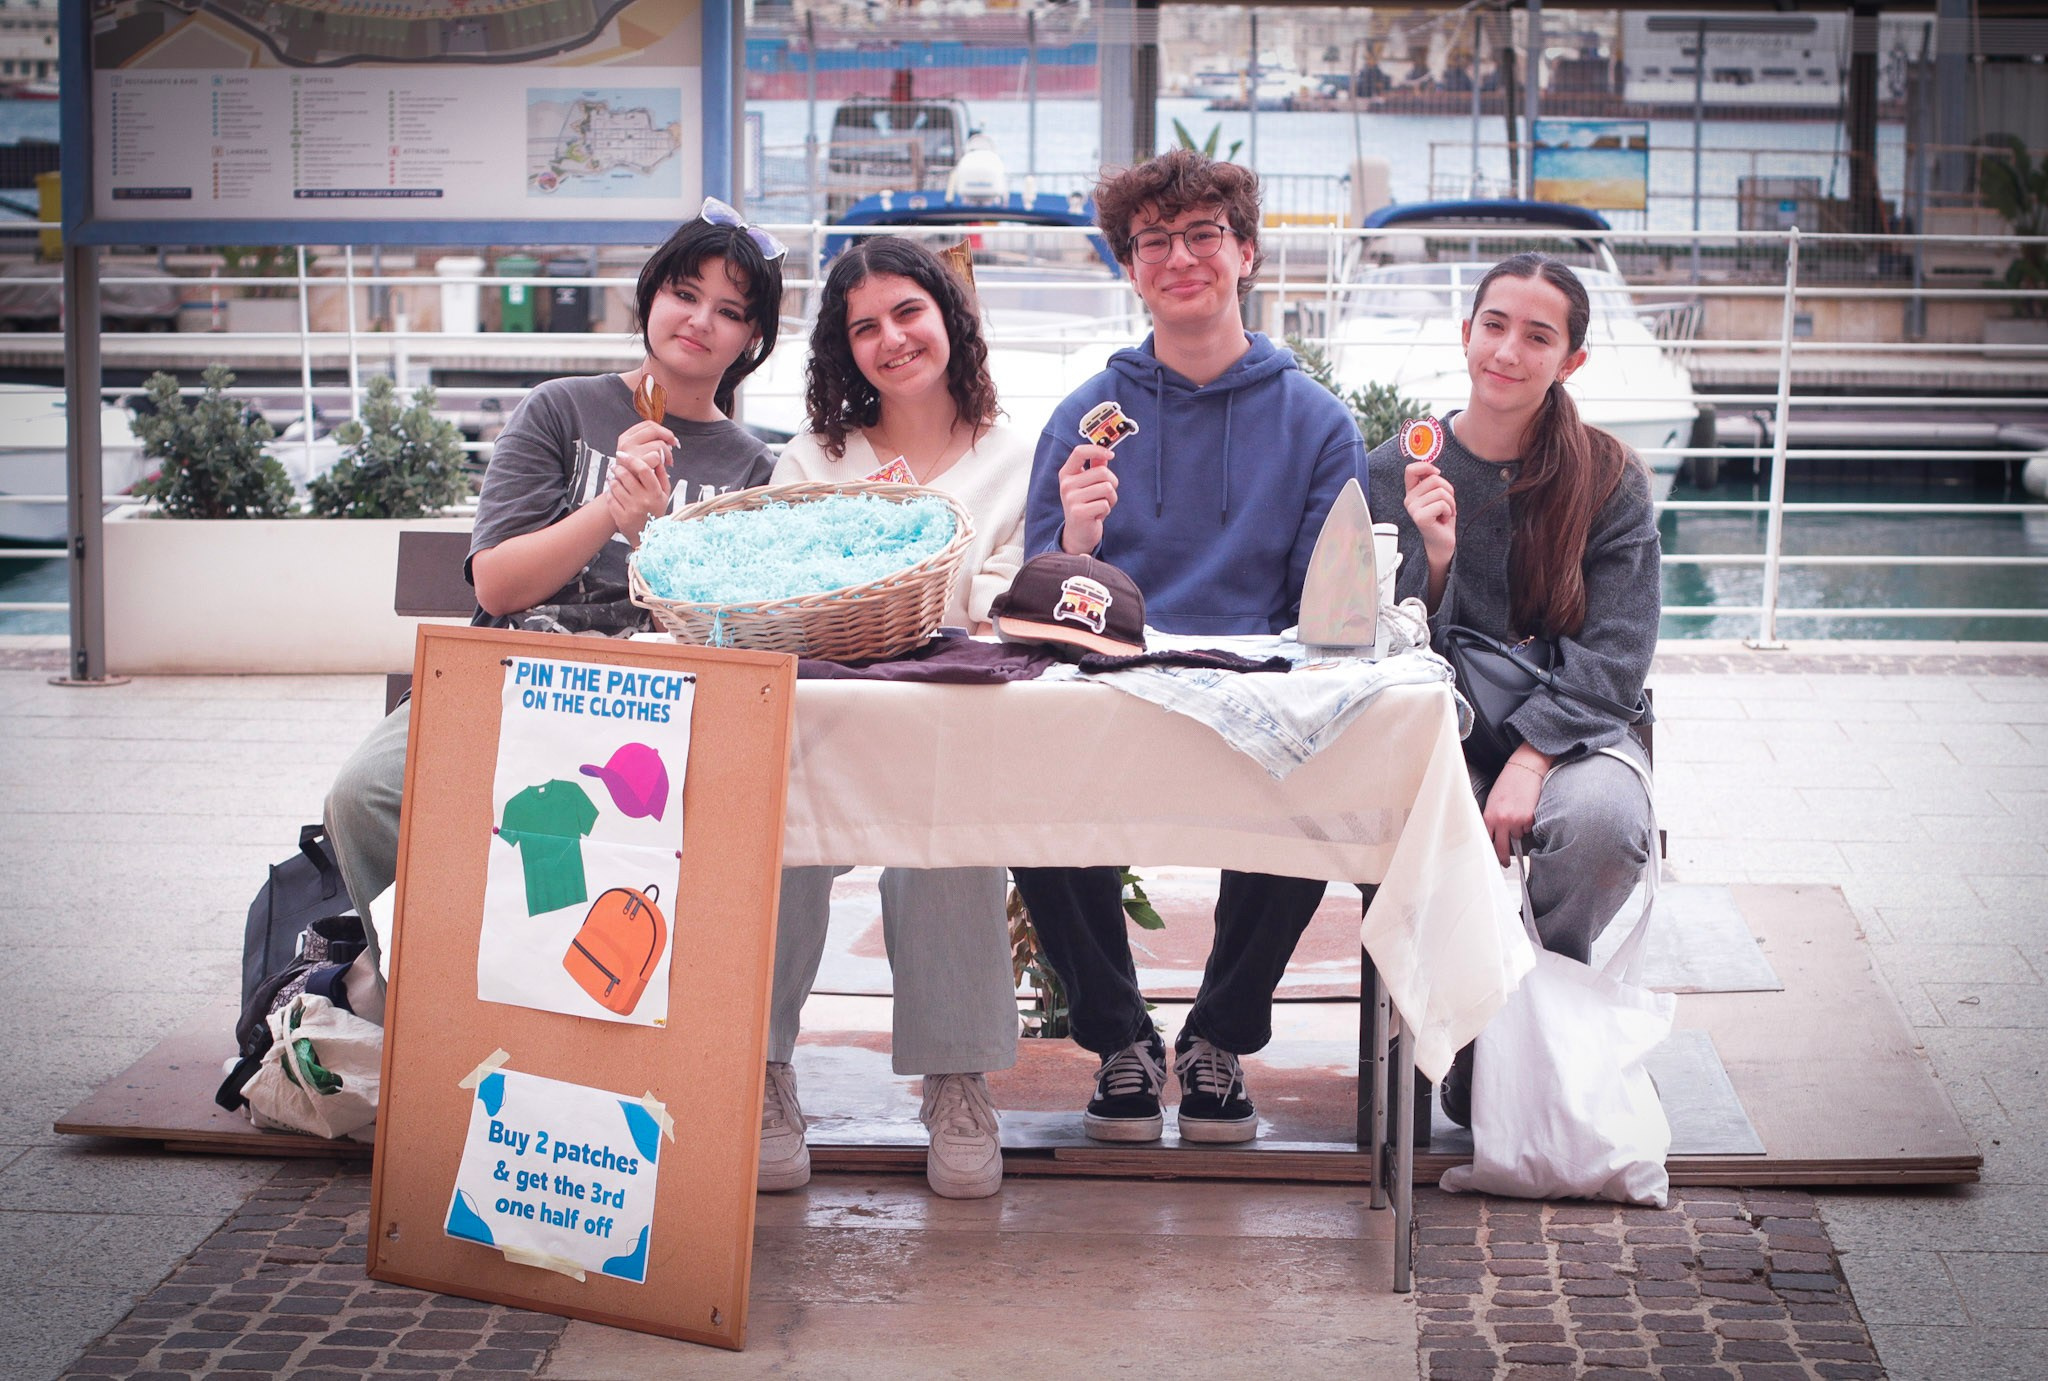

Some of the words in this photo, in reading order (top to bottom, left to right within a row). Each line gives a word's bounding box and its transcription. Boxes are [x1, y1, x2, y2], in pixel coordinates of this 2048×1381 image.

[515, 662, 553, 687] PIN
[560, 666, 600, 692] THE
[607, 671, 682, 701] PATCH
[523, 690, 546, 709] ON
[552, 693, 584, 714] THE
[590, 697, 670, 723] CLOTHES
[489, 1120, 530, 1156] Buy
[535, 1131, 549, 1155] 2
[553, 1141, 639, 1175] patches
[493, 1160, 510, 1182] &
[516, 1170, 548, 1192] get
[554, 1176, 585, 1199] the
[591, 1182, 625, 1209] 3rd
[495, 1198, 535, 1219] one
[540, 1202, 580, 1229] half
[584, 1216, 614, 1238] off
